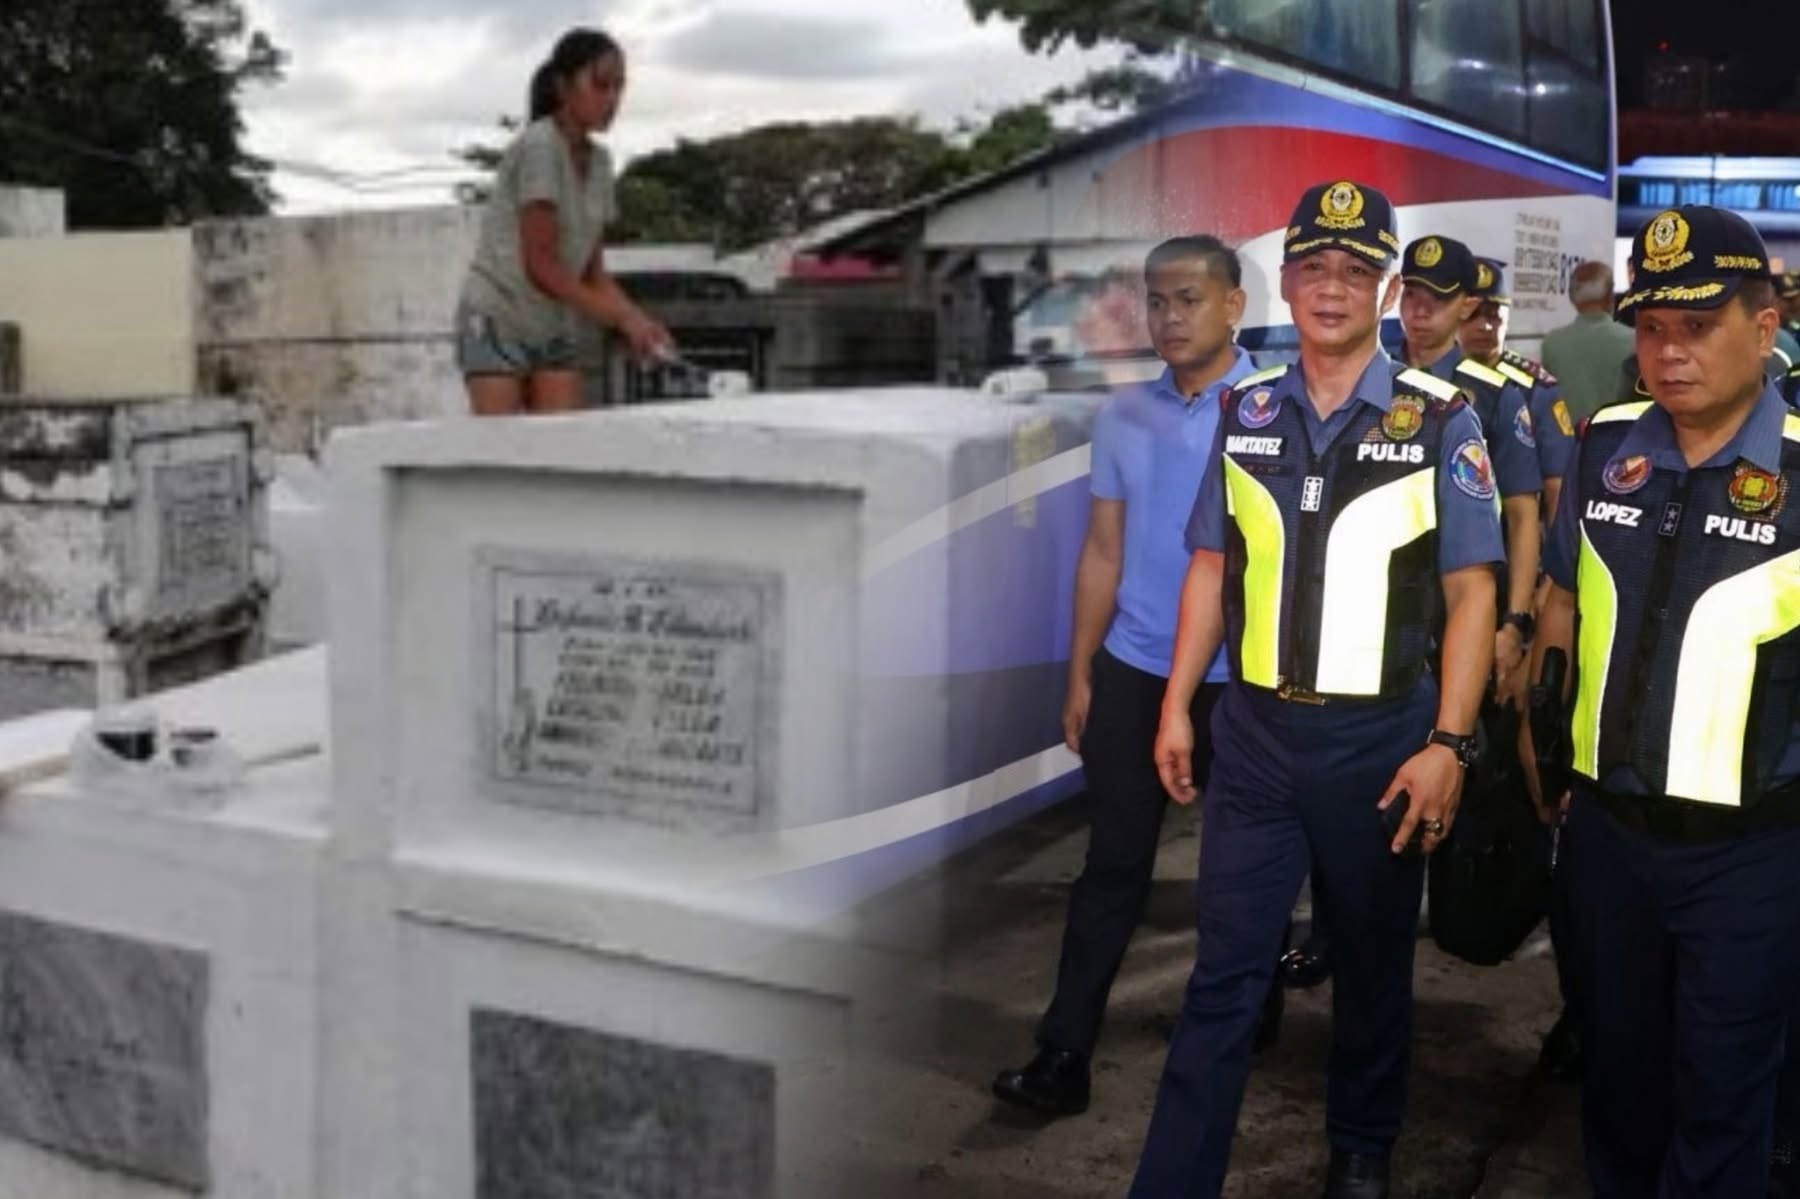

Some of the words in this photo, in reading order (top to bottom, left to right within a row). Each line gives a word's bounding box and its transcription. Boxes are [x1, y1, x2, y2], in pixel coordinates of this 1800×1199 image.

[1356, 443, 1425, 463] PULIS
[1585, 500, 1643, 528] LOPEZ
[1704, 514, 1777, 545] PULIS
